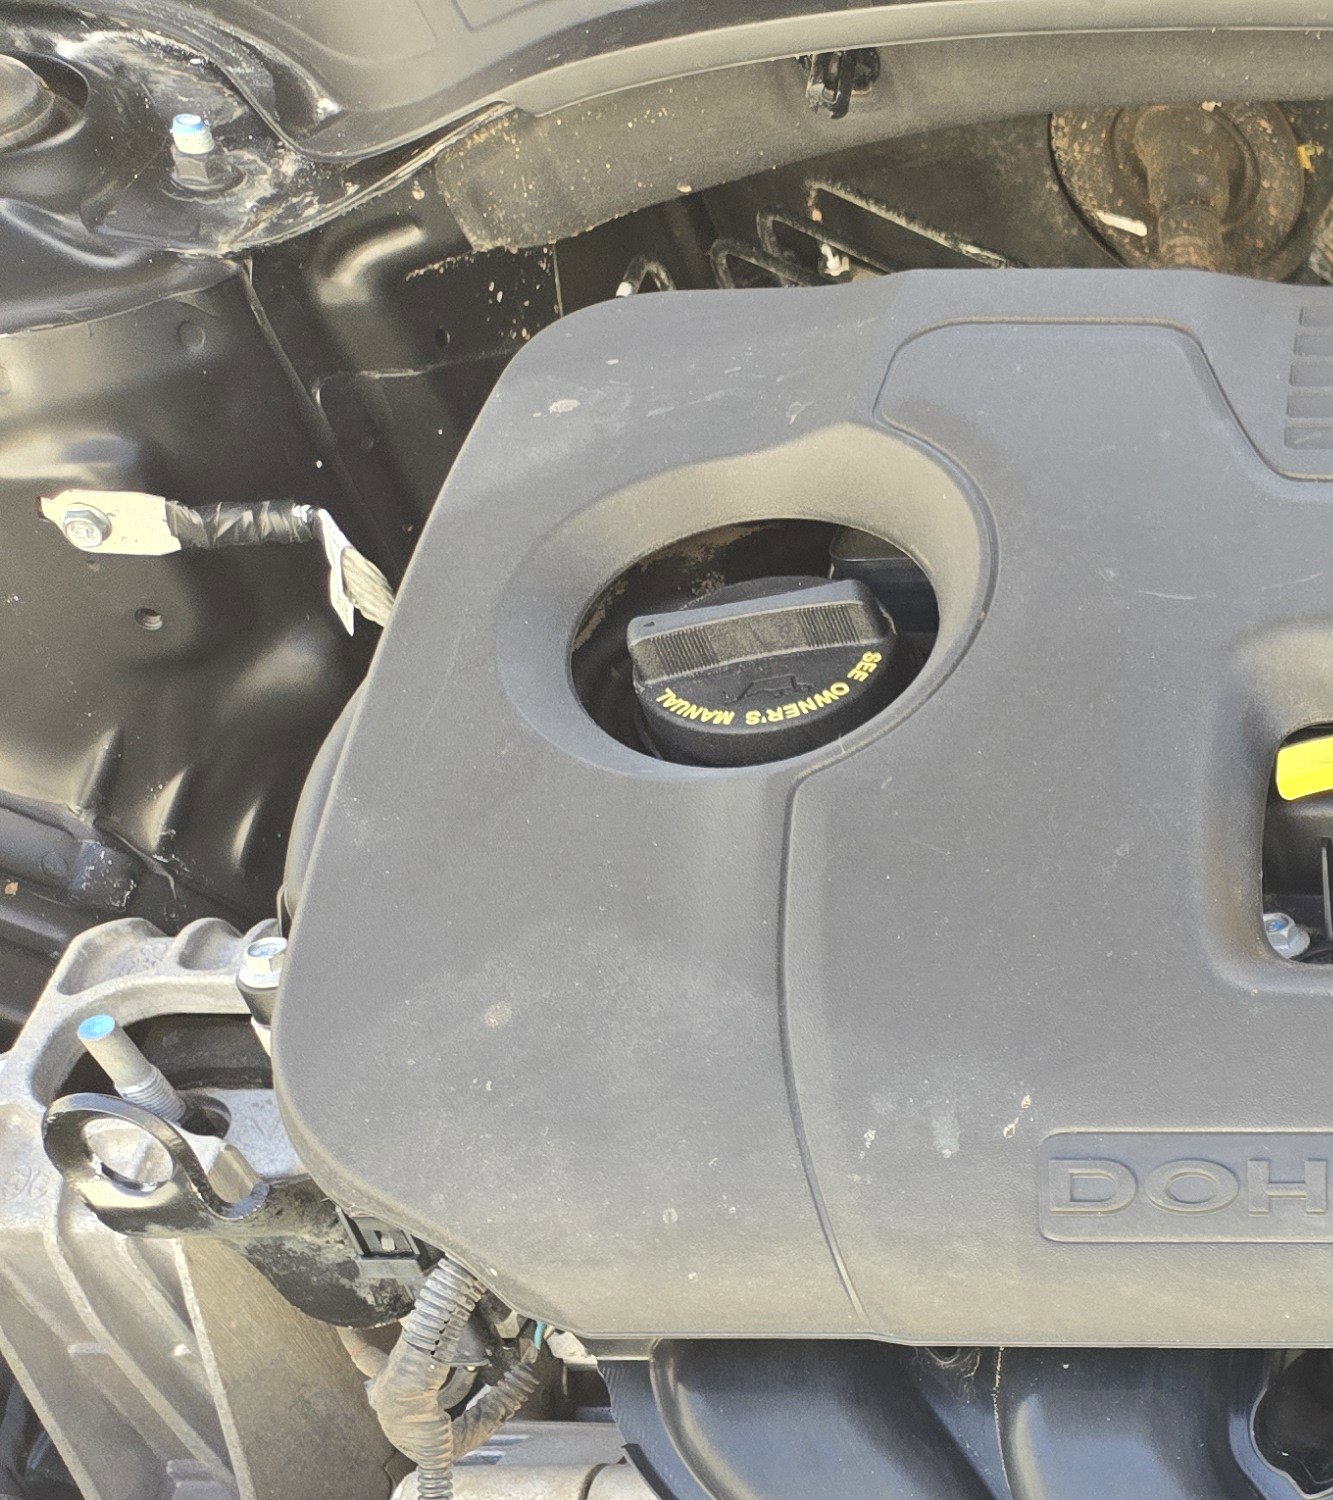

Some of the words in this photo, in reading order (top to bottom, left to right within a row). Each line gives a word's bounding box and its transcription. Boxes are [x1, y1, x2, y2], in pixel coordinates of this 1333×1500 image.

[846, 650, 882, 684] SEE
[655, 687, 735, 726] MANUAL
[745, 681, 850, 726] OWNER'S
